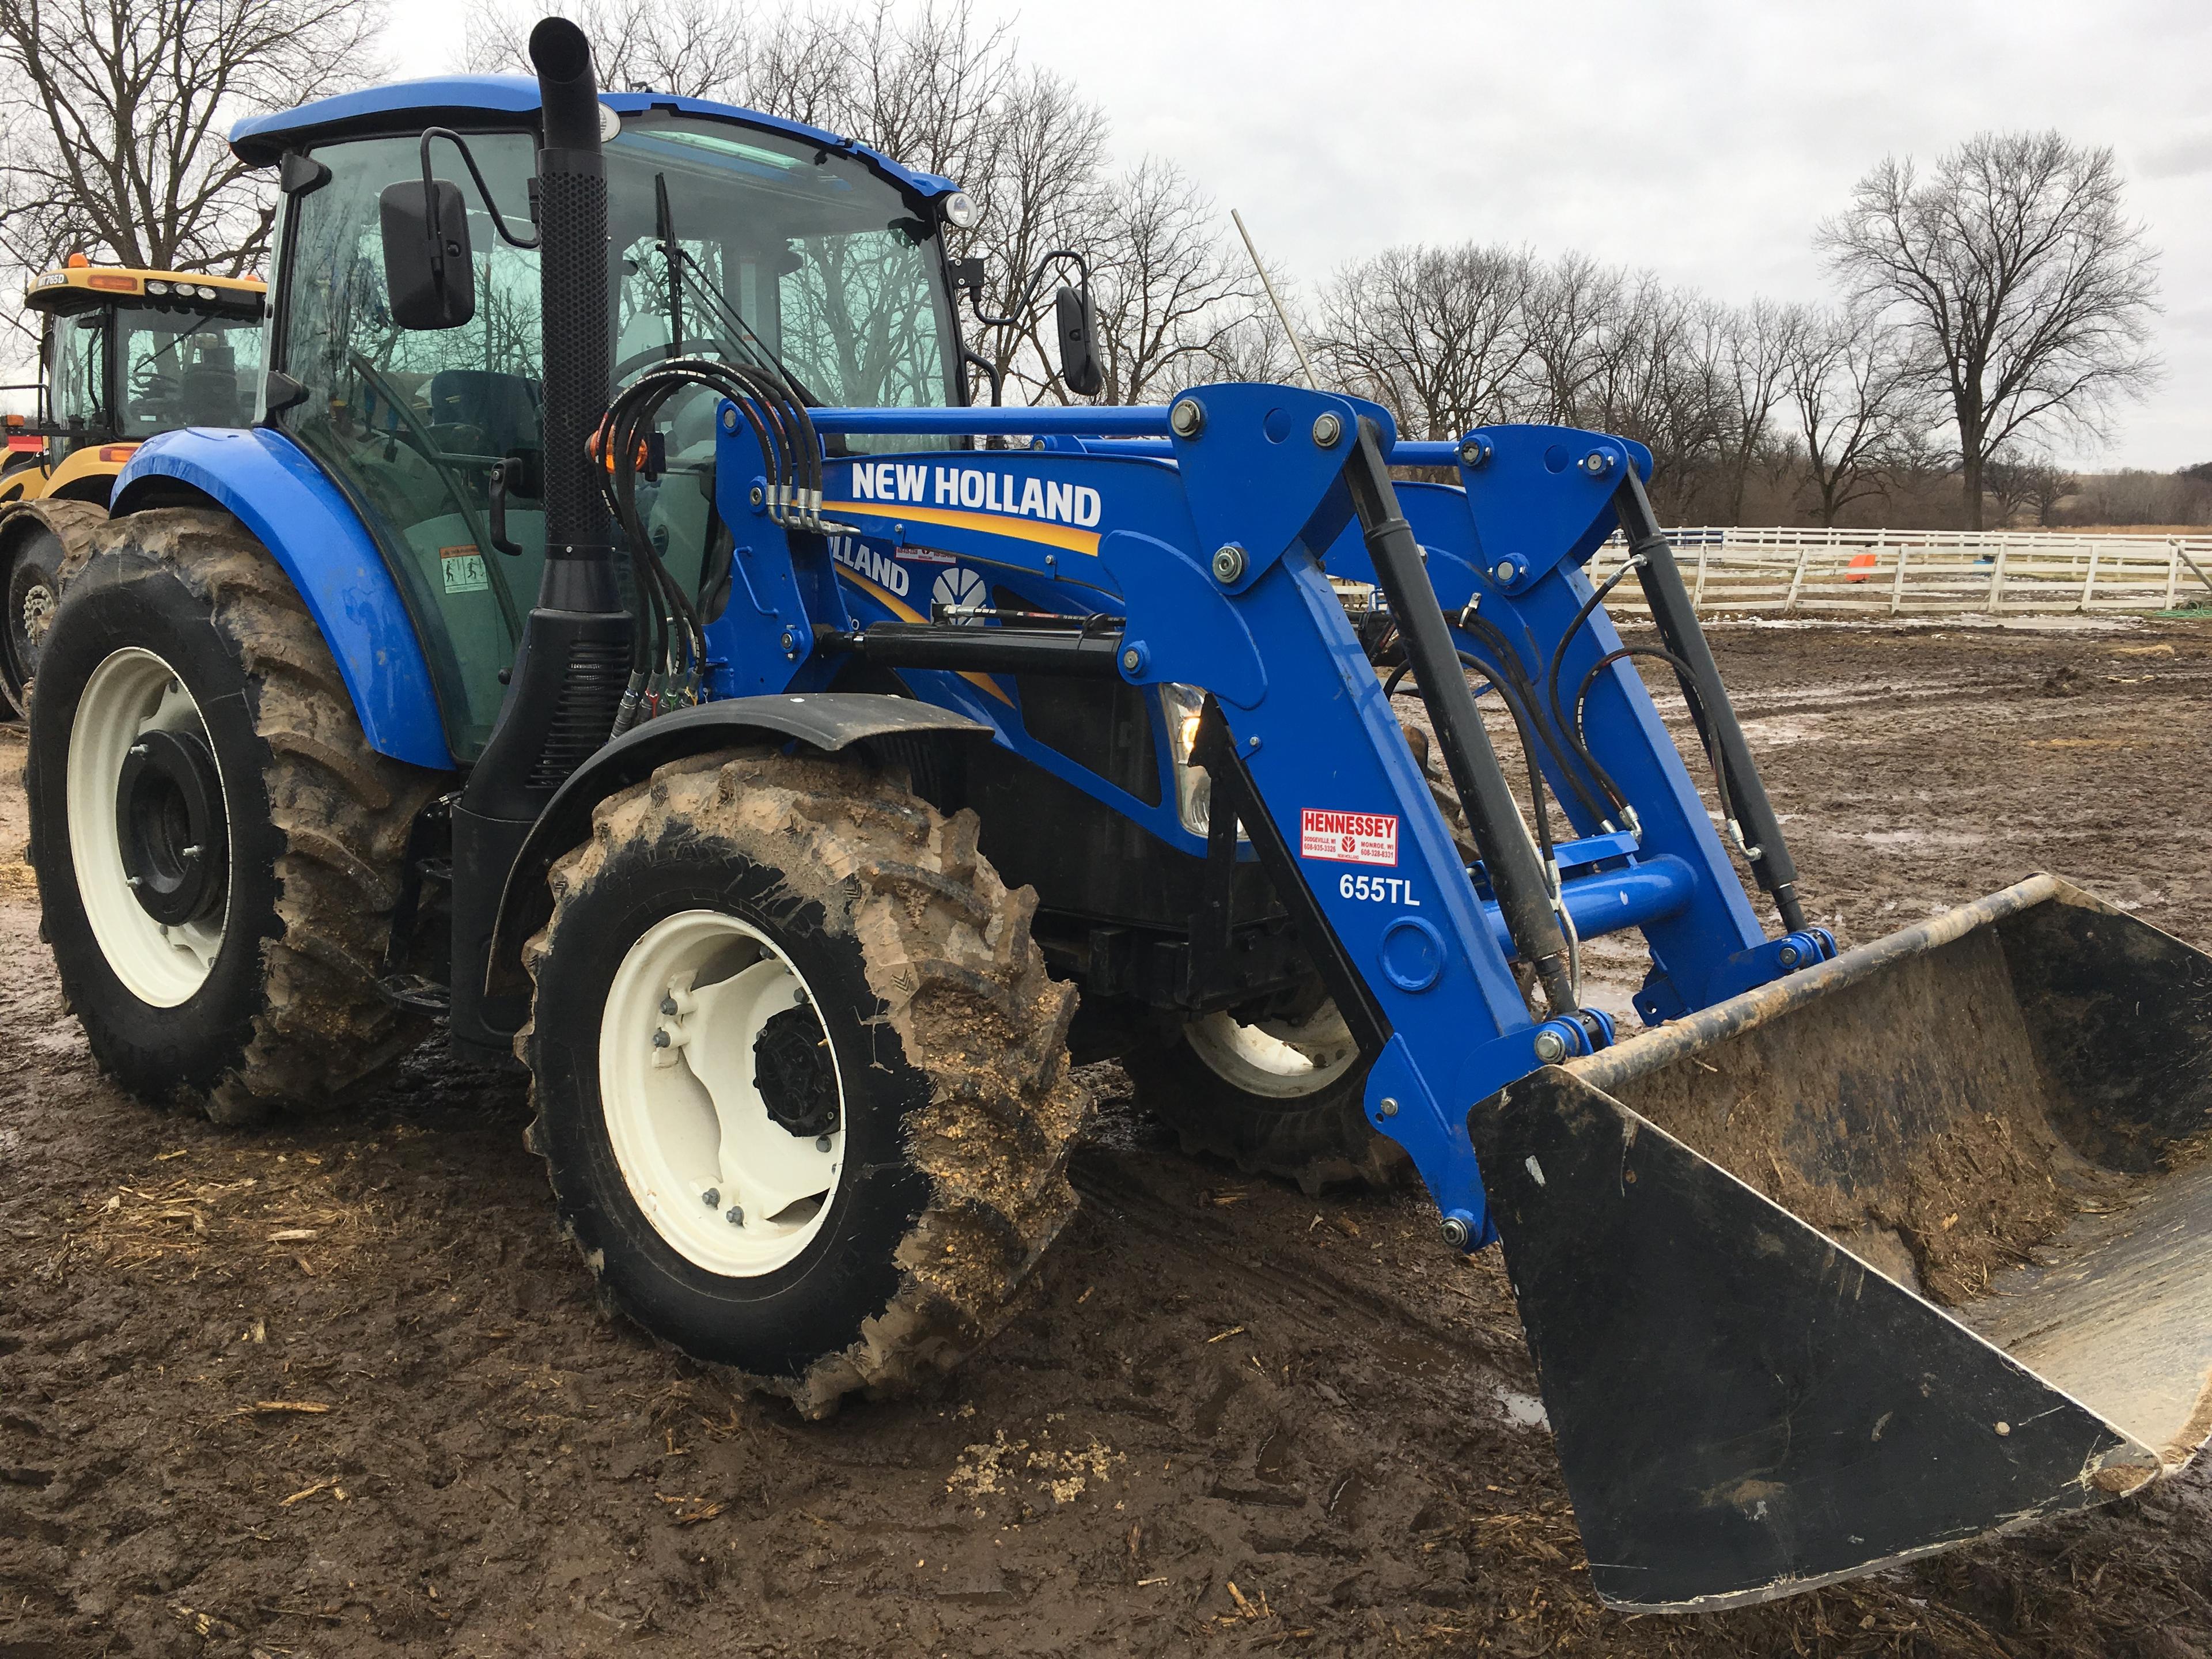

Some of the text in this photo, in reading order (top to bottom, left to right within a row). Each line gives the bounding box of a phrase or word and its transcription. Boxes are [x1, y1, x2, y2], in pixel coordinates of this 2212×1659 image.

[853, 463, 1101, 527] NEW HOLLAND
[830, 536, 909, 597] LLAND
[1305, 812, 1395, 838] HENNESSEY
[1361, 841, 1385, 850] MONROE,
[1339, 874, 1420, 906] 655TL
